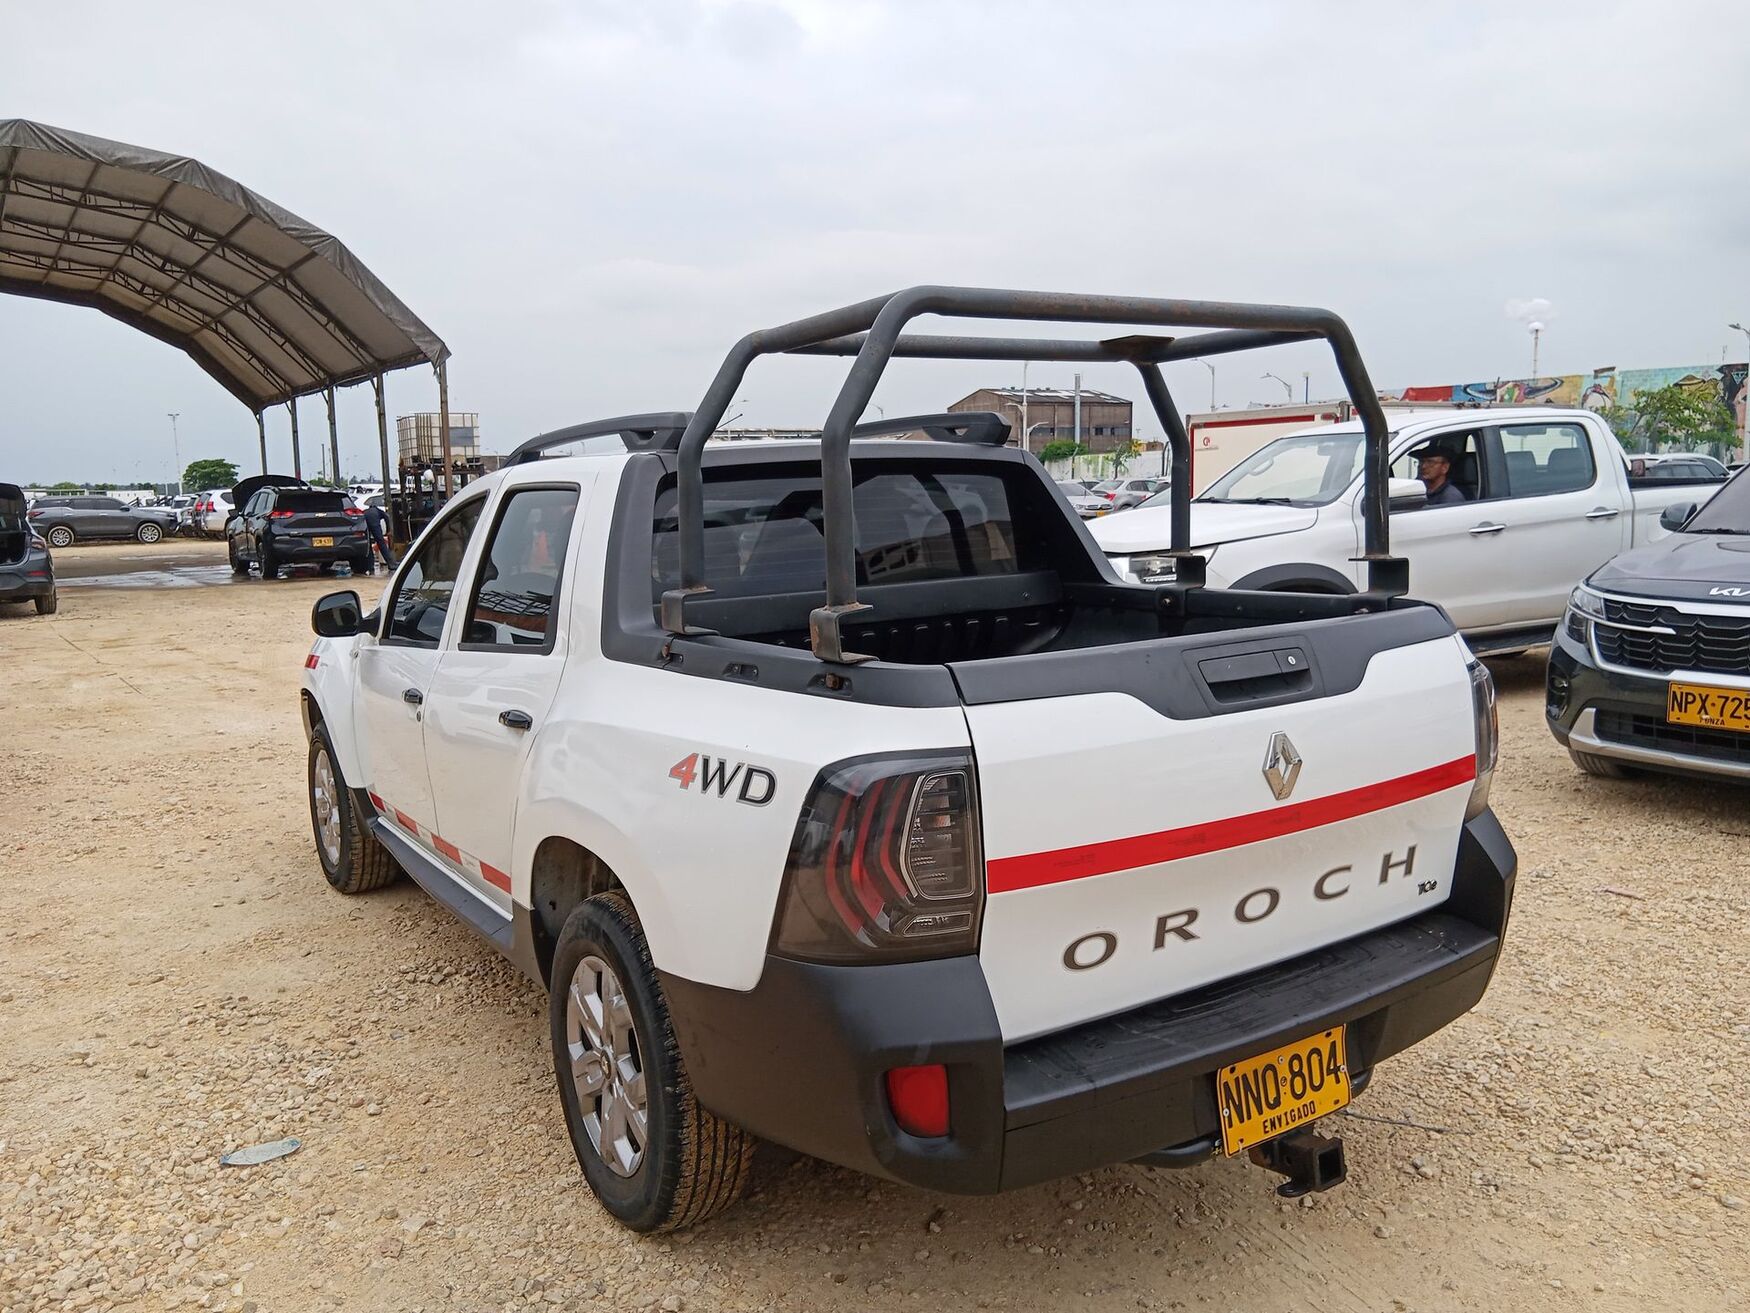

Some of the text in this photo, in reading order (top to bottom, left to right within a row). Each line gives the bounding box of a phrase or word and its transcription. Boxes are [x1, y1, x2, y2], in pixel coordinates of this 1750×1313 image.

[668, 752, 778, 808] 4WD
[1062, 844, 1418, 971] OROCH
[1262, 1100, 1317, 1134] ENVIGADO
